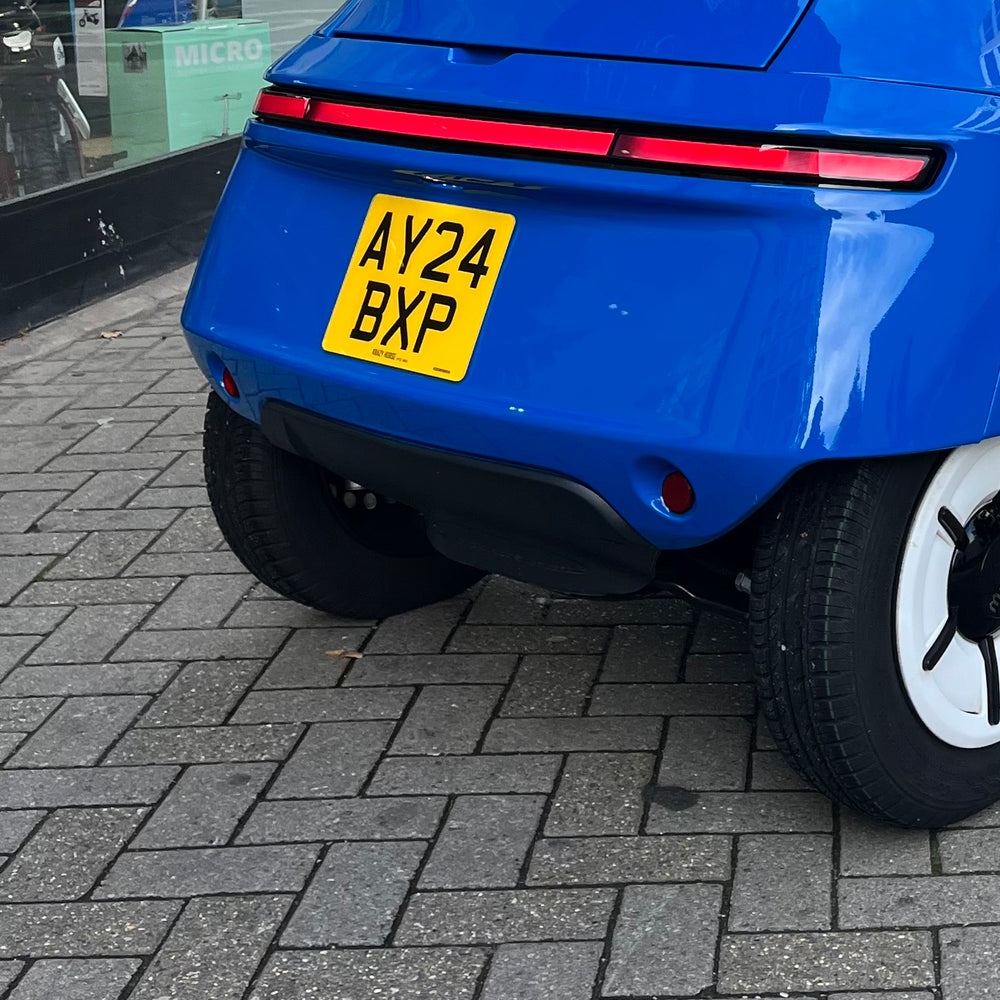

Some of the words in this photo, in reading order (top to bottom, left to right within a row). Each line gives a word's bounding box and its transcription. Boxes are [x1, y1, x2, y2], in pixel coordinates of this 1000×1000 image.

[175, 38, 262, 67] MICRO
[359, 212, 496, 289] AY24
[350, 281, 457, 353] BXP
